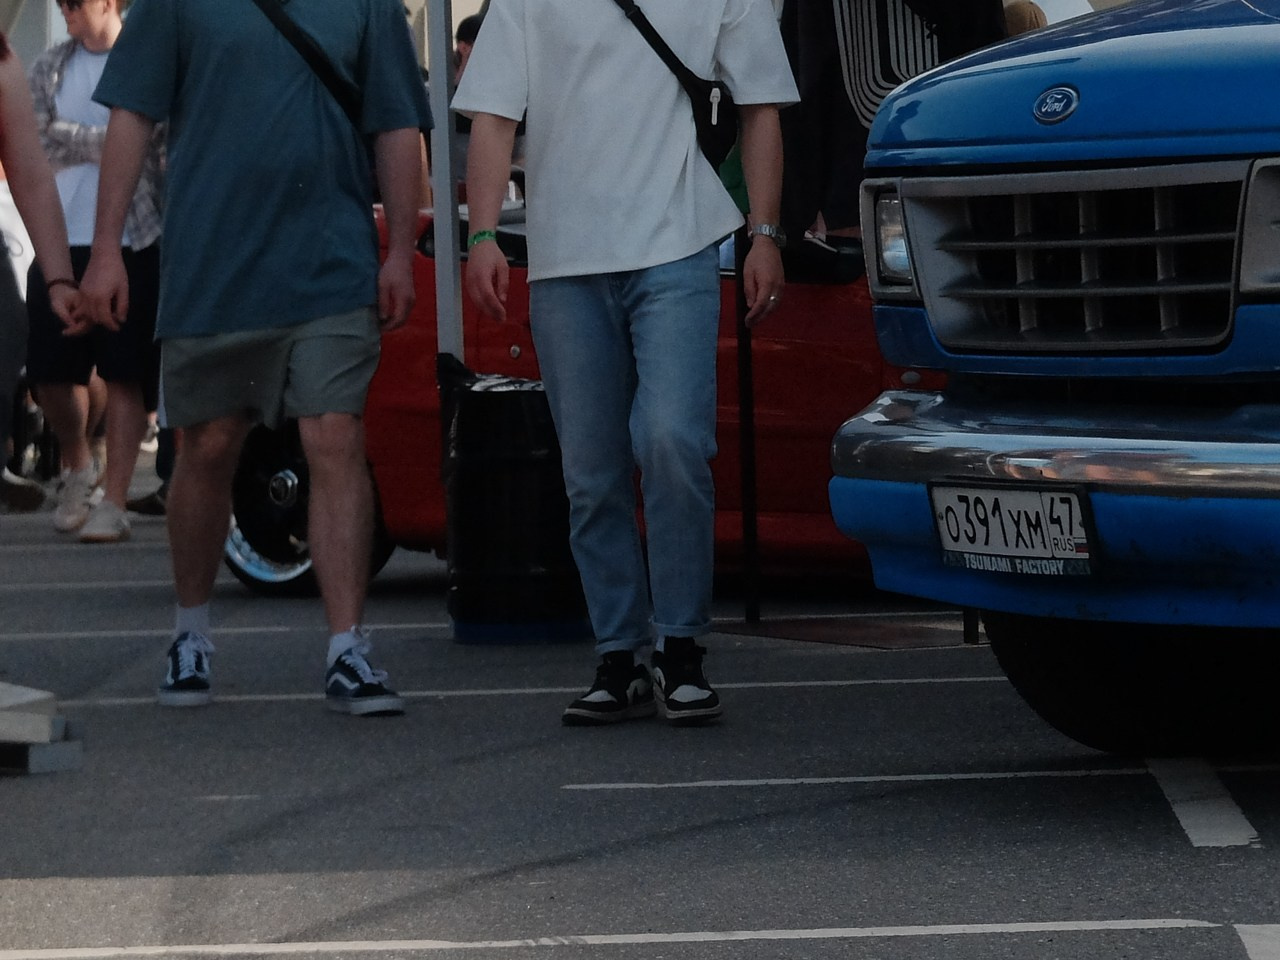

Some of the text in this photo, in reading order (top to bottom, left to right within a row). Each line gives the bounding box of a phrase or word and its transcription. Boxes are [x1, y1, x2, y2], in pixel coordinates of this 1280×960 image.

[1053, 537, 1074, 552] RUS
[964, 553, 1064, 576] TSUNAMI FACTORY
